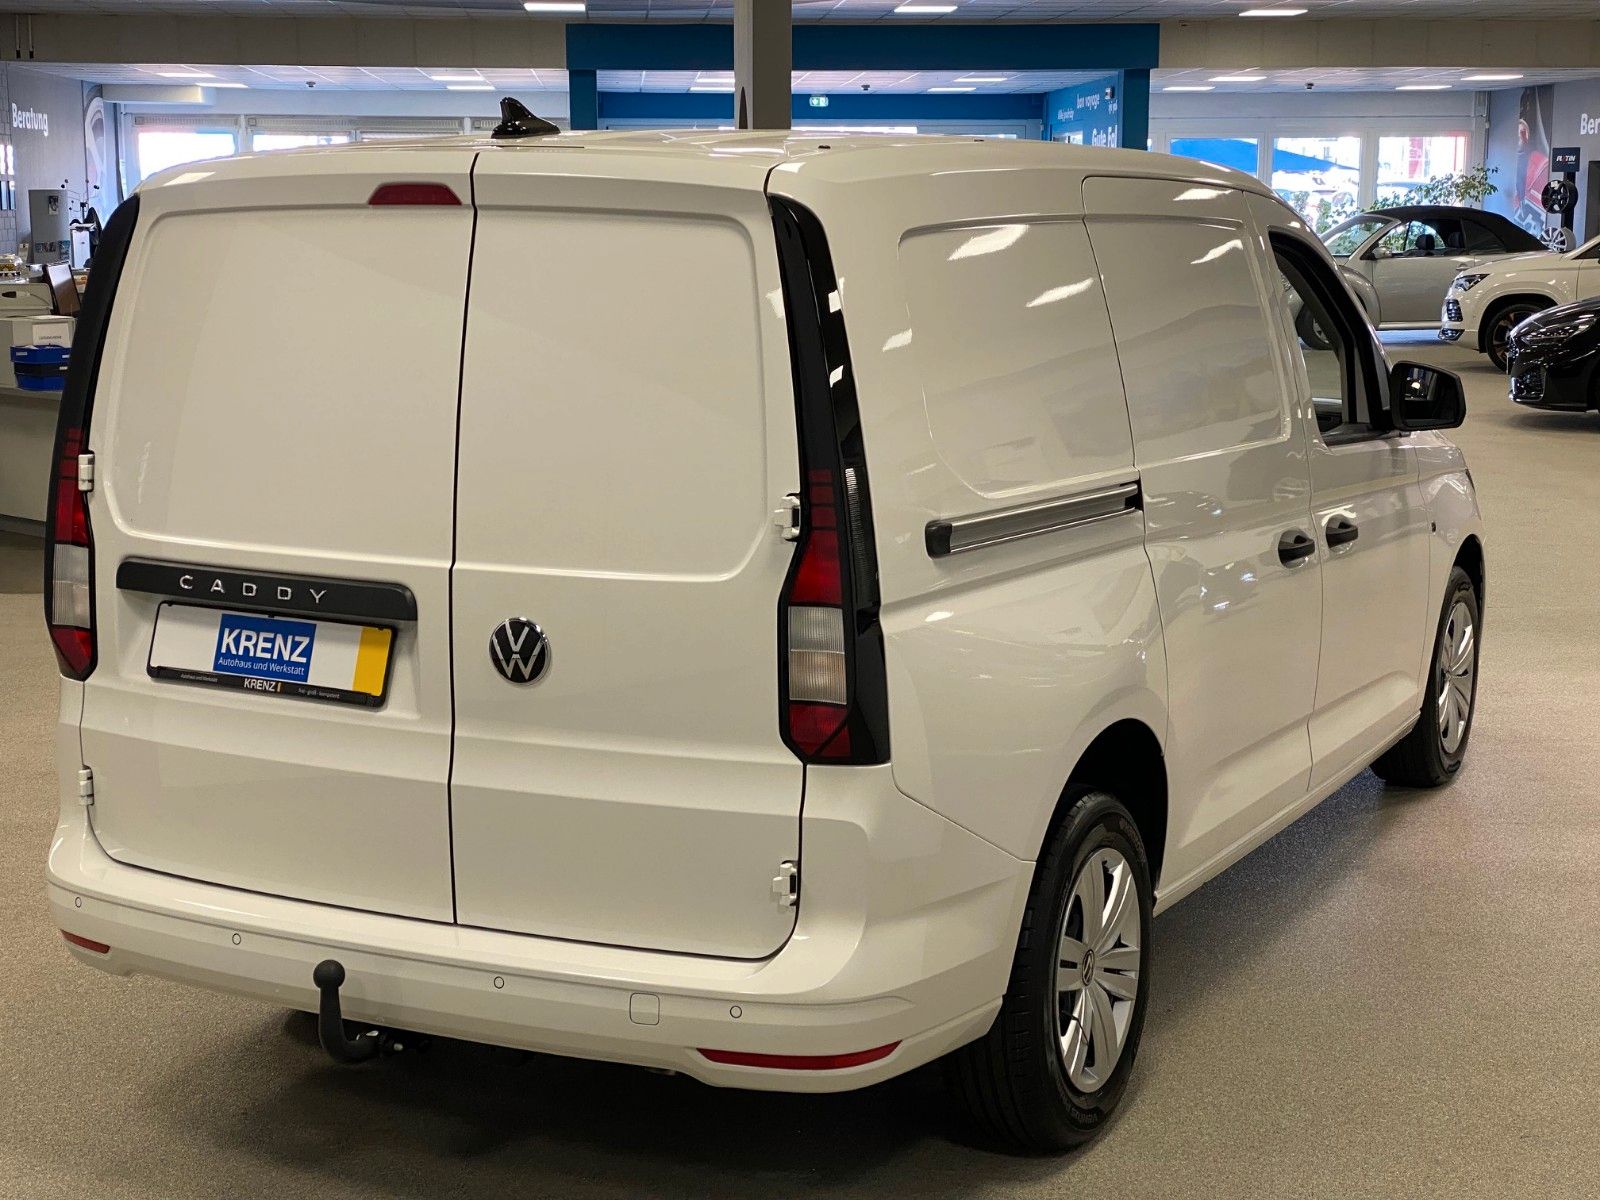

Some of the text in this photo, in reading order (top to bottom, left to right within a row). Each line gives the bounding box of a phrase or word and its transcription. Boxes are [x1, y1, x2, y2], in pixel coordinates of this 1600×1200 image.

[11, 102, 49, 137] Beratung
[178, 574, 327, 604] CADDY
[220, 627, 310, 663] KRENZ
[217, 656, 305, 676] Autohaus und Werkstatt
[243, 677, 276, 692] KRENZ
